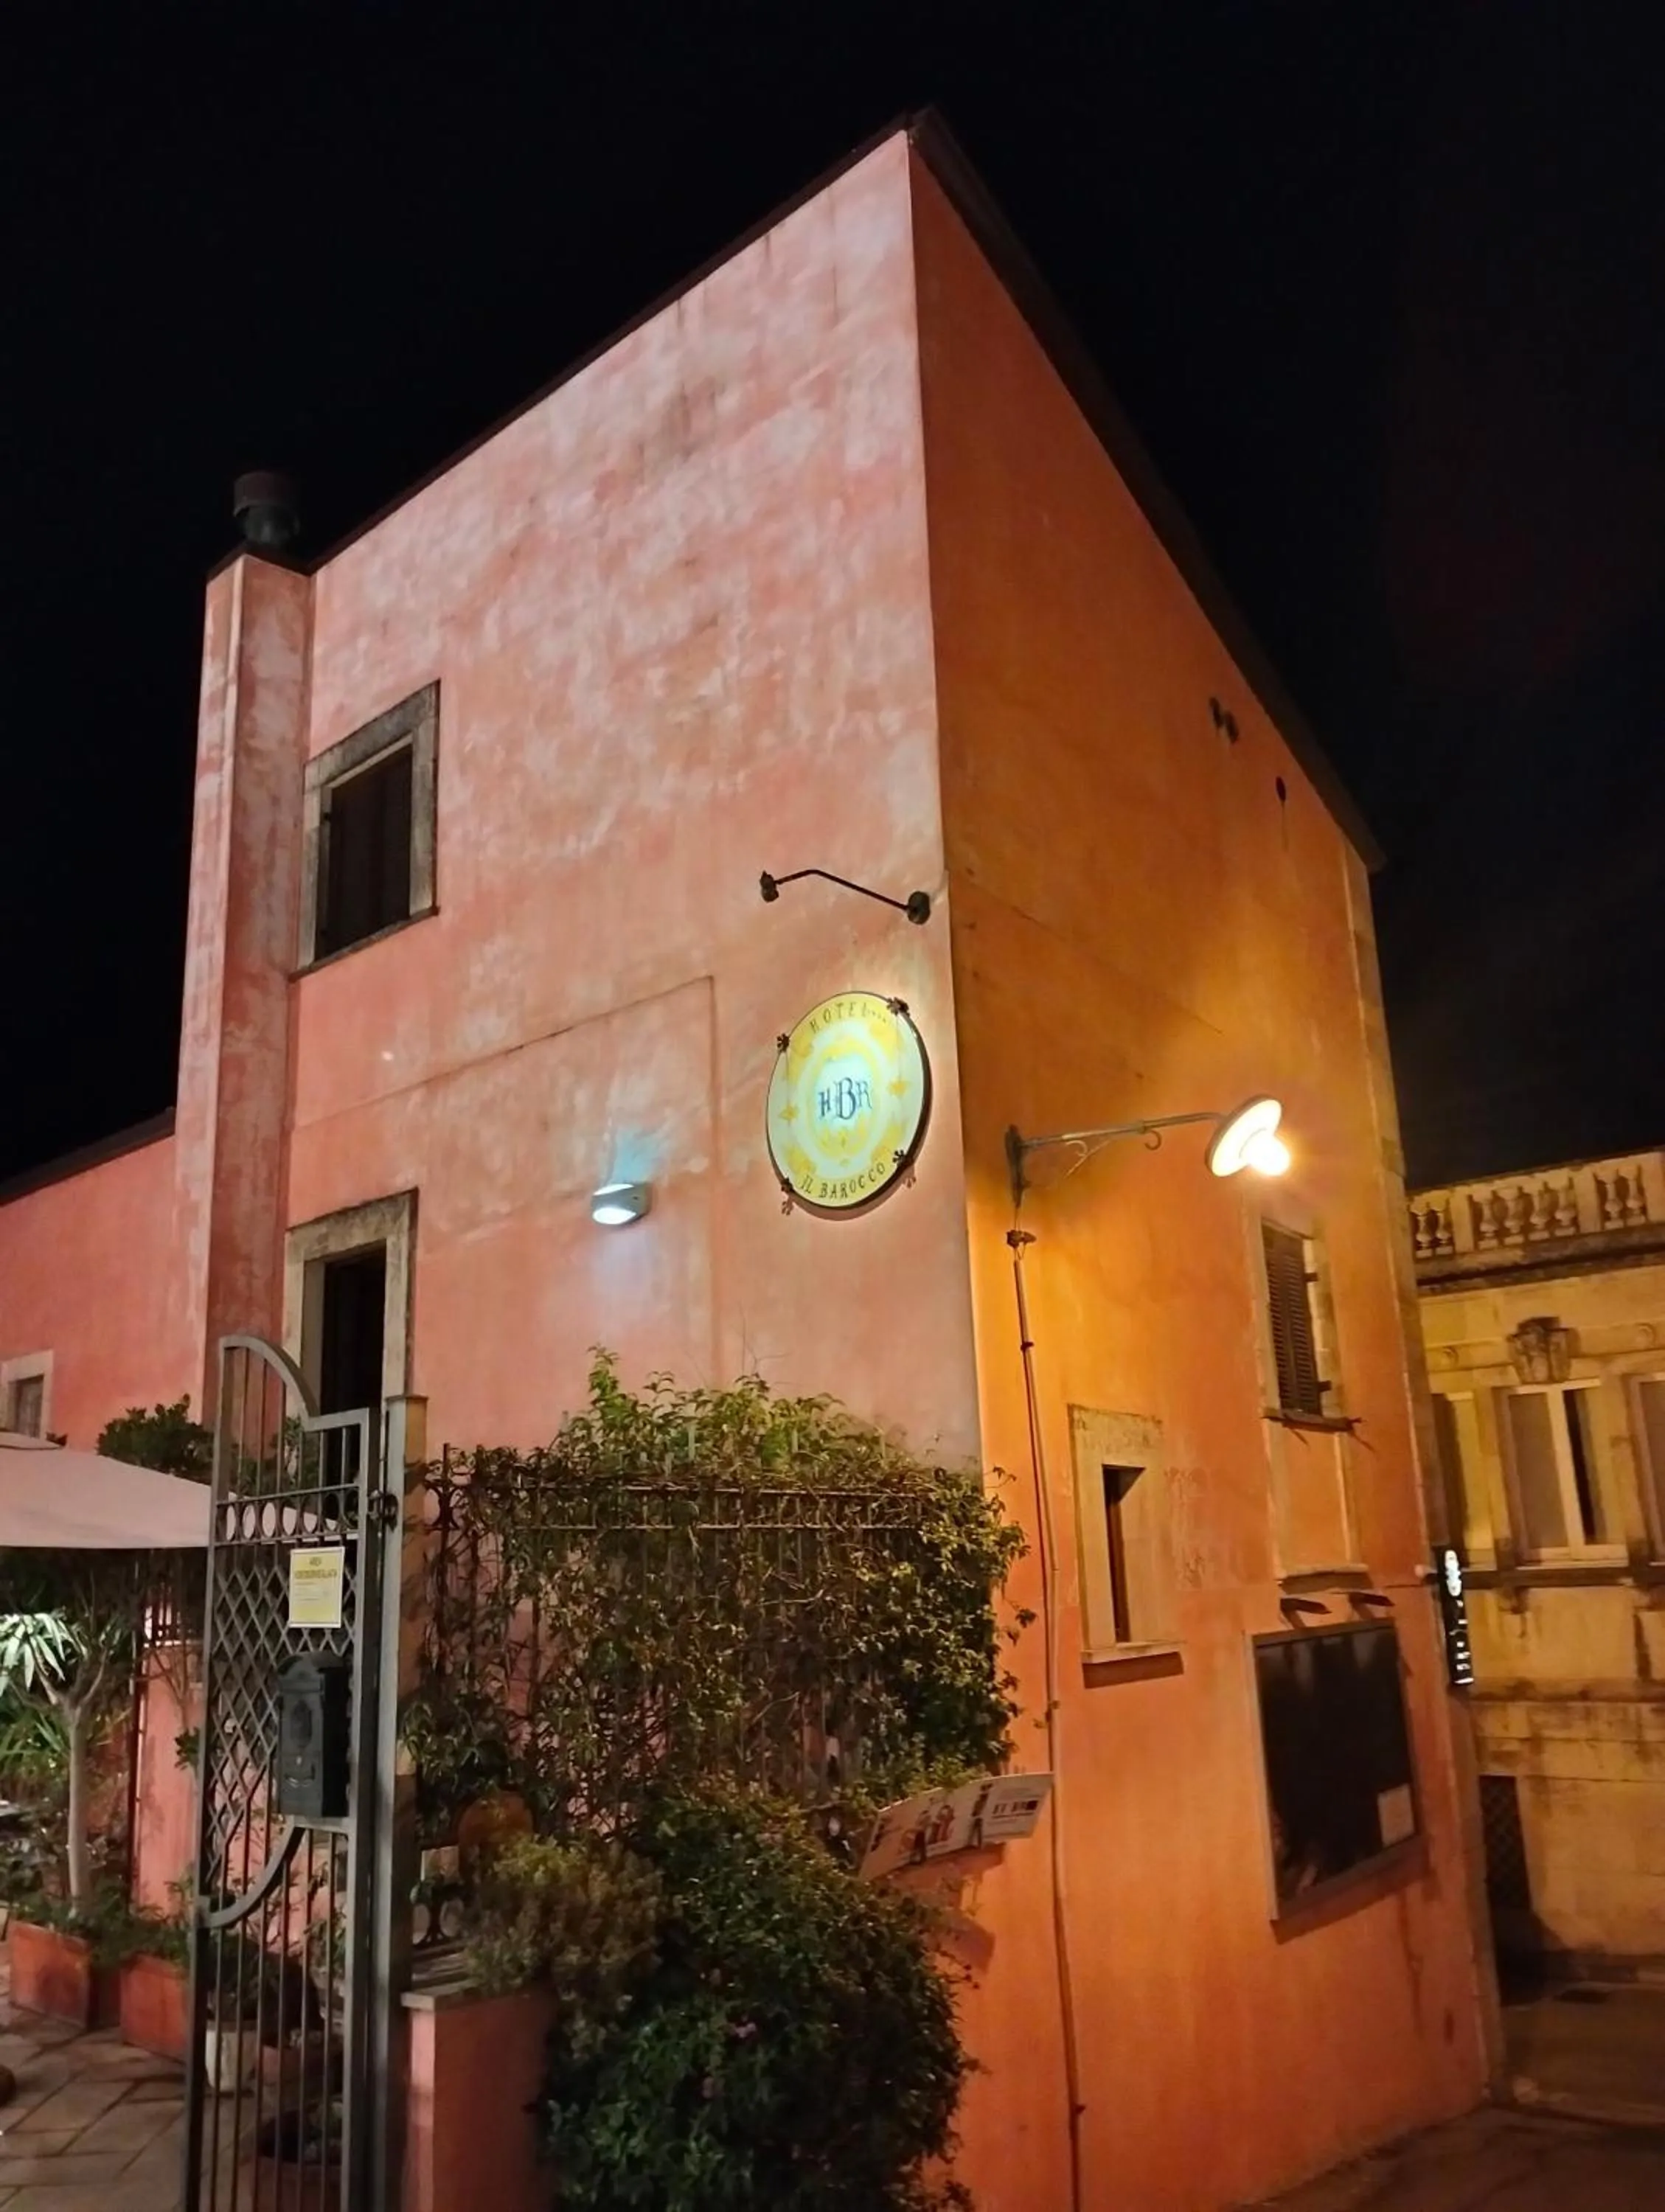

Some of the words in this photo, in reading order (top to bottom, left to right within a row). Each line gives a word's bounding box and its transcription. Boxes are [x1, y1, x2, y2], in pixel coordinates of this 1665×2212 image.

[810, 1002, 870, 1034] HOTEL
[800, 1175, 813, 1194] IL
[818, 1162, 886, 1198] BAROCCO
